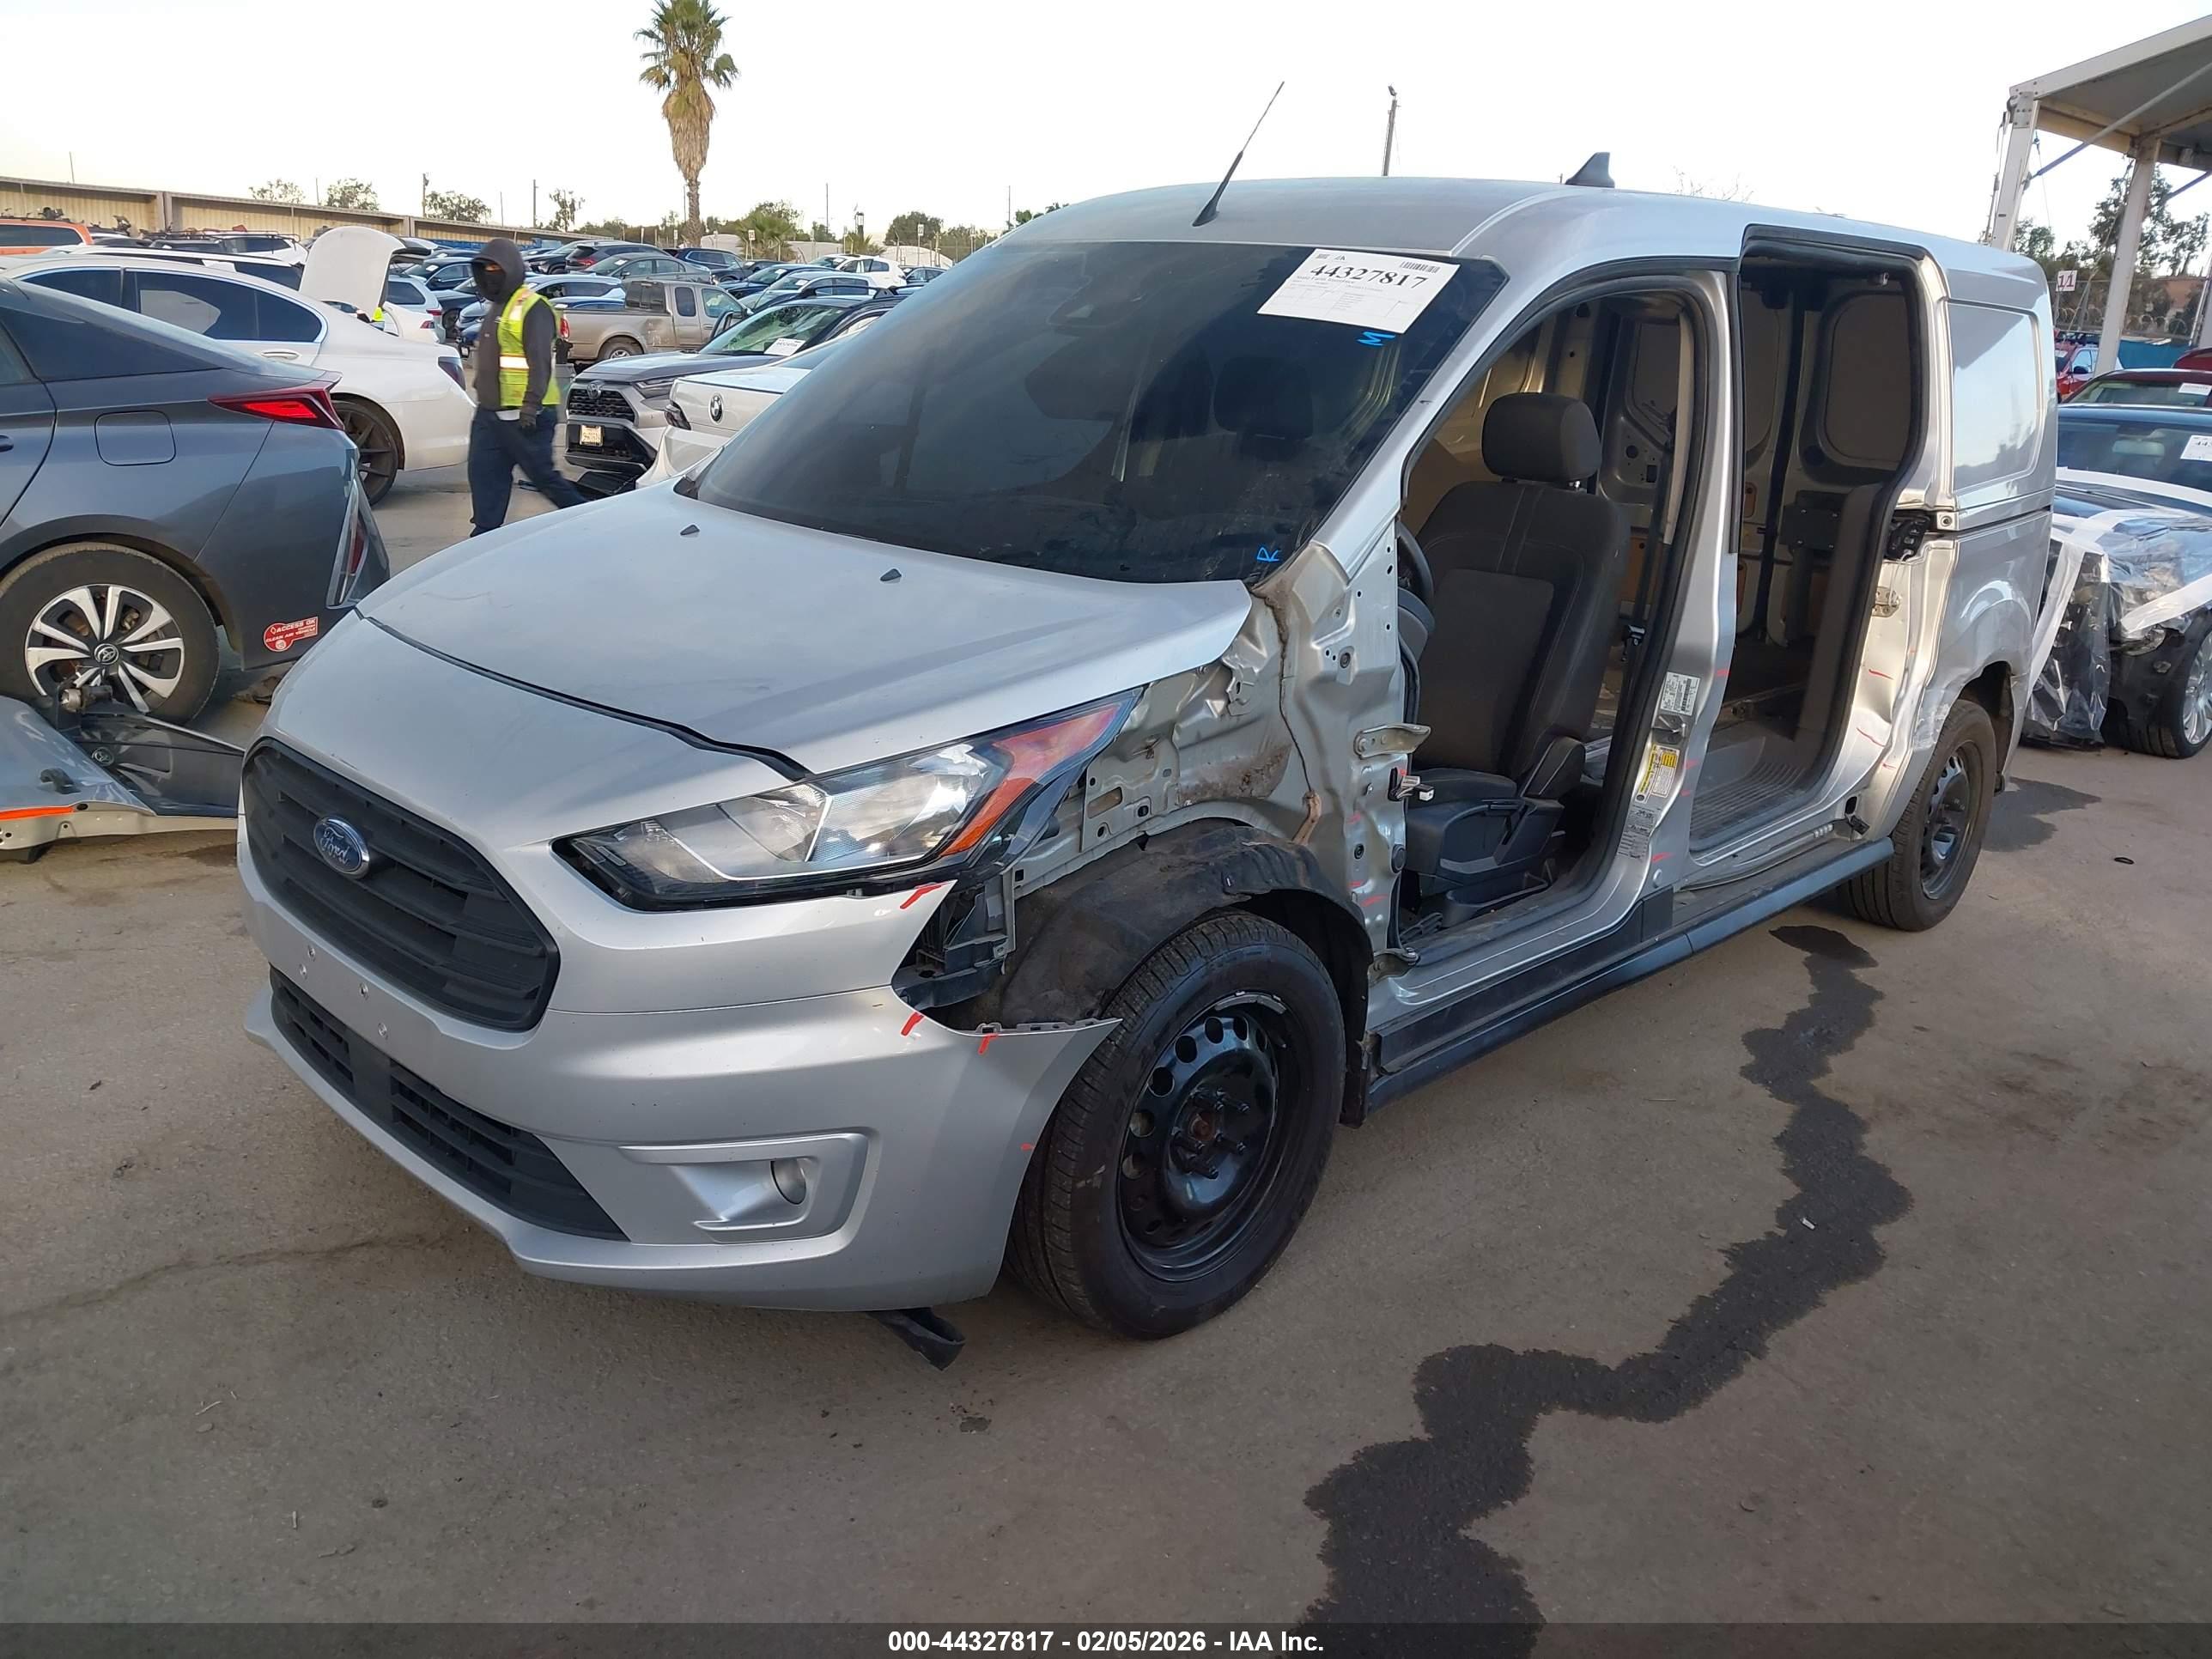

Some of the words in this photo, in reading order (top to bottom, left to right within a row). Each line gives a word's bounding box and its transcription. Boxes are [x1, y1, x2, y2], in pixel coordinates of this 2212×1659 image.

[1310, 264, 1428, 289] 44327817
[2058, 275, 2075, 288] 11
[320, 827, 349, 864] Ford
